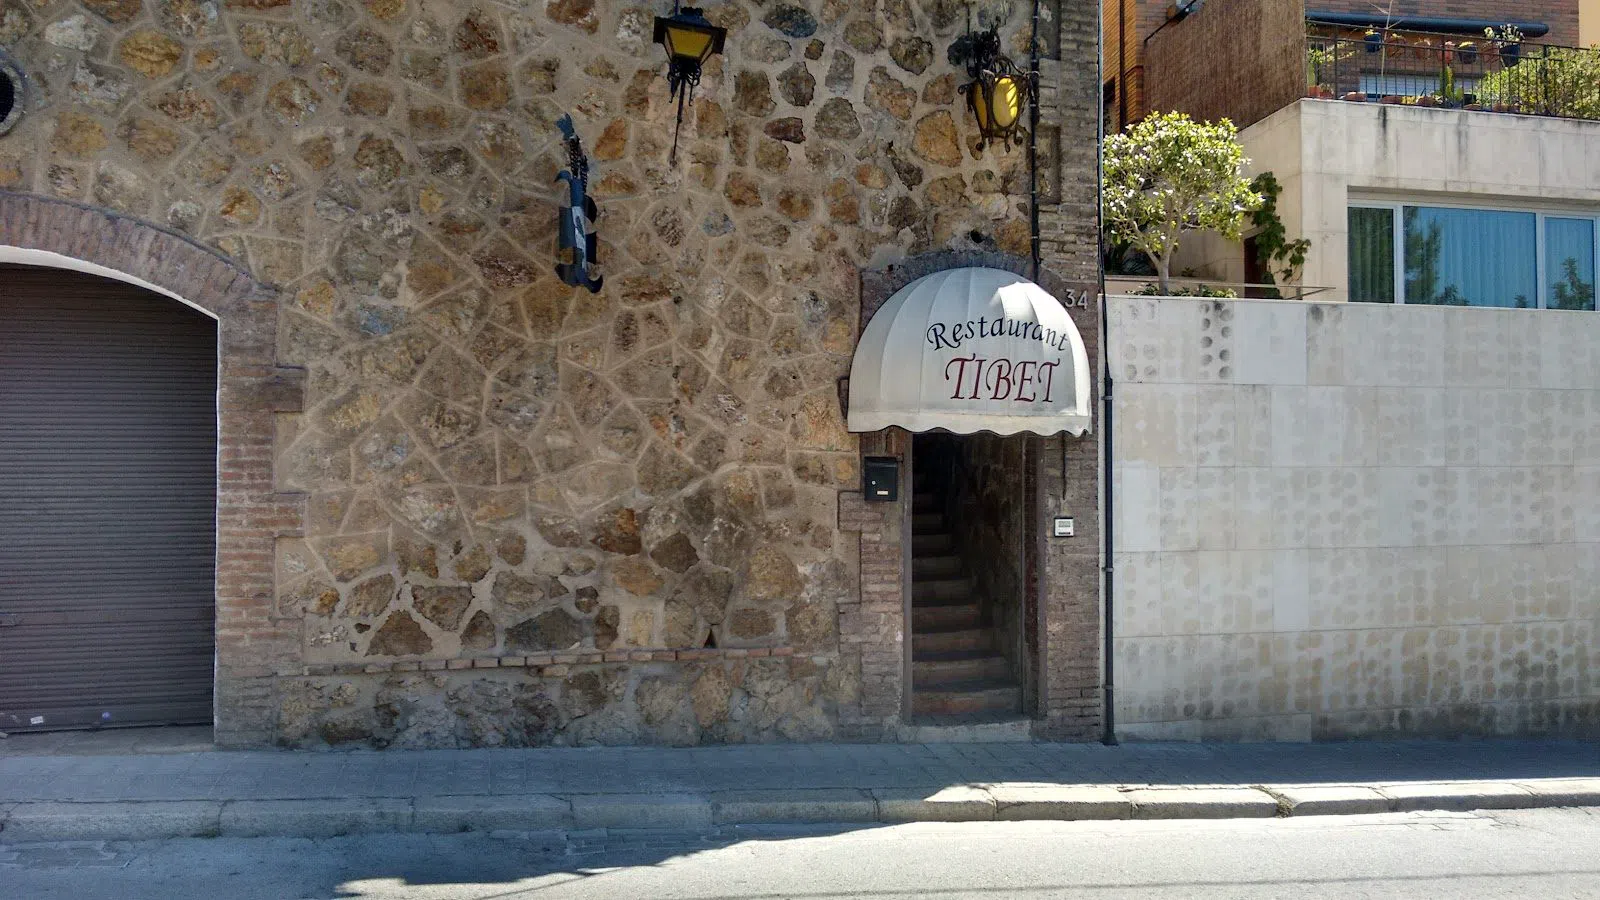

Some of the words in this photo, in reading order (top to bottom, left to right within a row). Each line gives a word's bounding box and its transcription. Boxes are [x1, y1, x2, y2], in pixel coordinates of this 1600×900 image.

[1064, 288, 1089, 310] 34
[926, 315, 1069, 351] Restaurant
[945, 353, 1060, 403] TIBET
